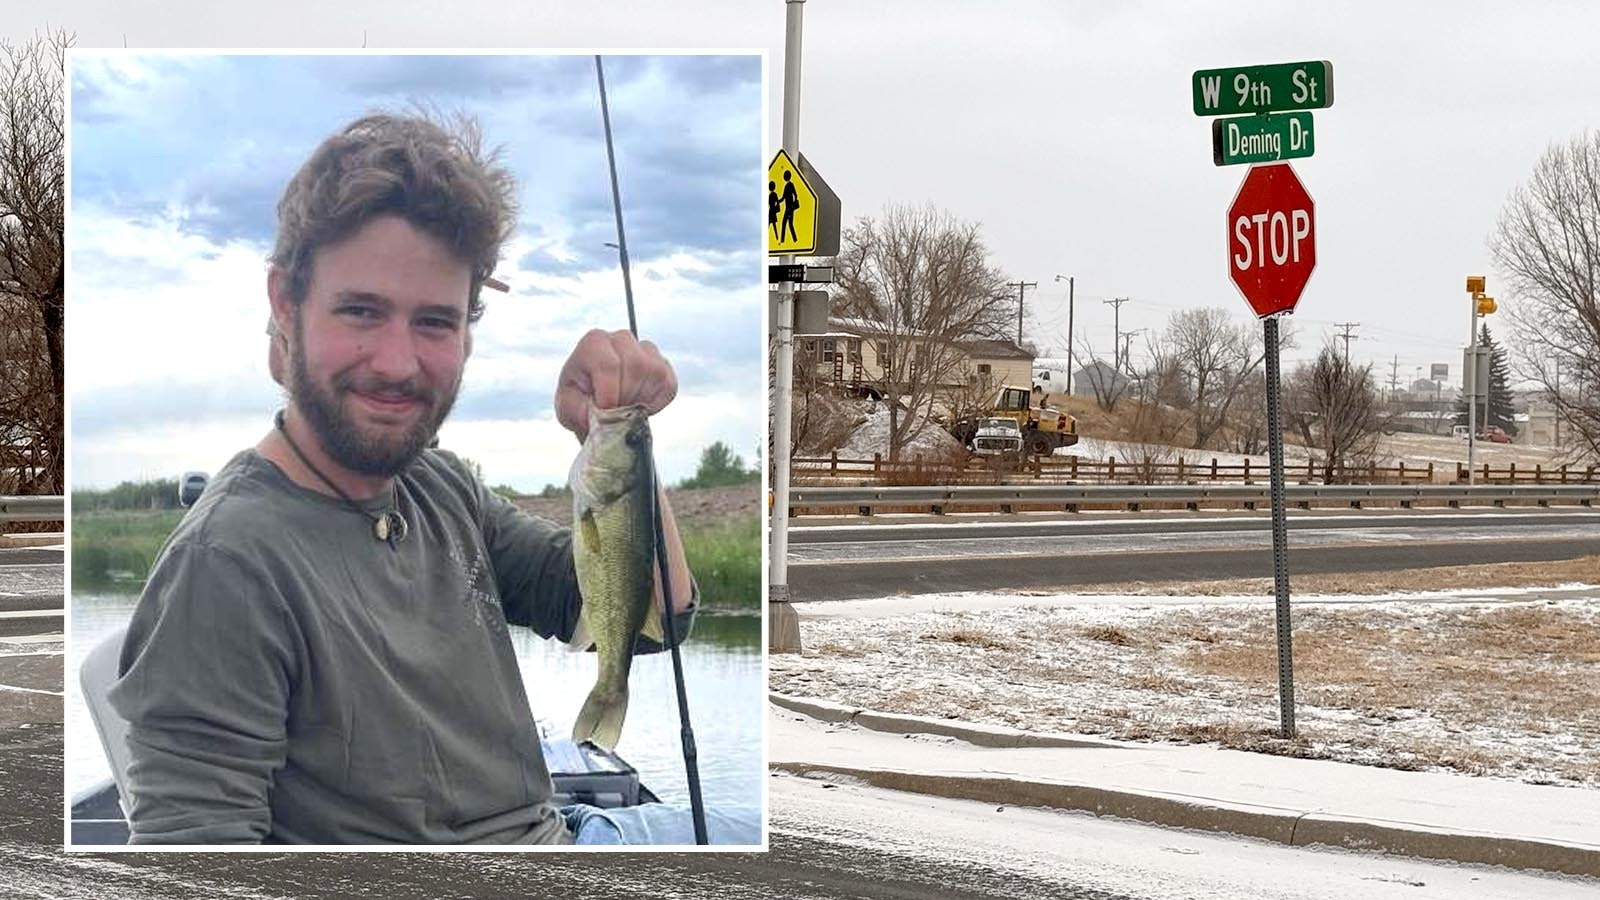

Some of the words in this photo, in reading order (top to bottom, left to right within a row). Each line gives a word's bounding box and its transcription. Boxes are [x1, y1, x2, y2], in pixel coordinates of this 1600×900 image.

[1200, 75, 1222, 109] W
[1233, 73, 1272, 107] 9th
[1291, 69, 1318, 104] St
[1228, 123, 1281, 160] Deming
[1289, 117, 1309, 151] Dr
[1234, 209, 1310, 271] STOP
